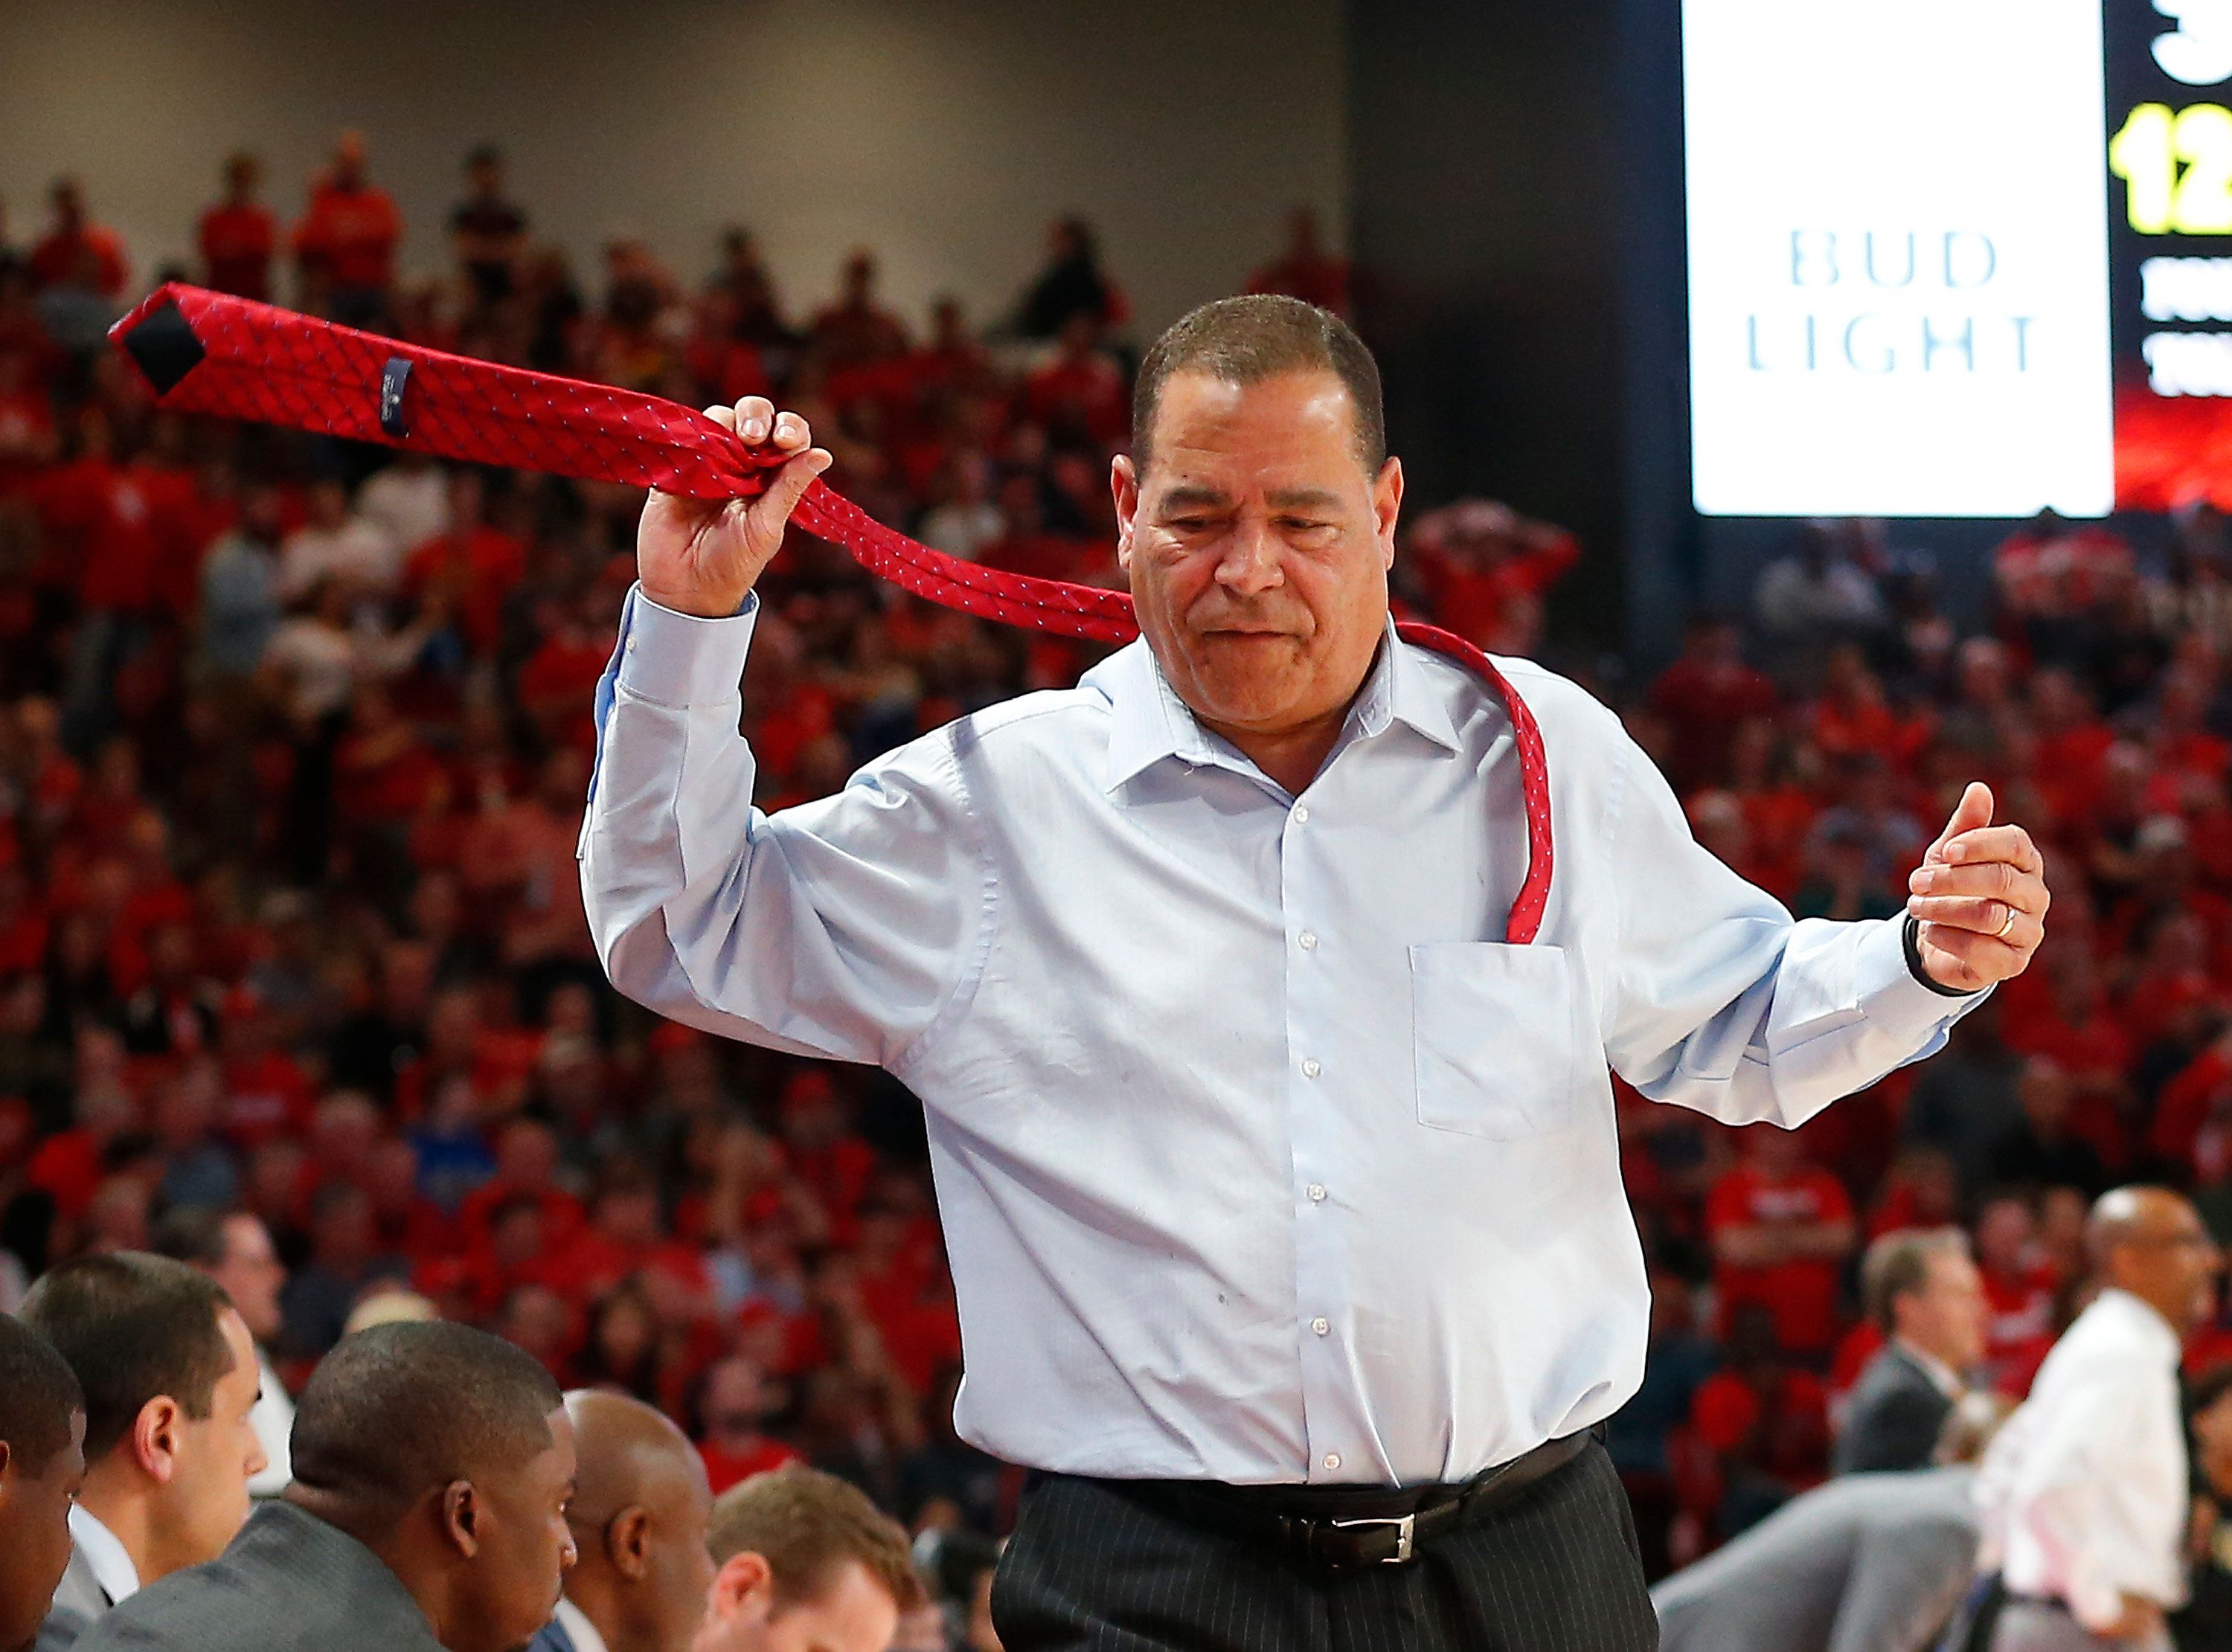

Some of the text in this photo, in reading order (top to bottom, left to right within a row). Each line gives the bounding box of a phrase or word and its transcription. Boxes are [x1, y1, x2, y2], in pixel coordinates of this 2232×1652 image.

[2108, 100, 2232, 236] 12
[1789, 228, 1998, 289] BUD
[1745, 313, 2036, 373] LIGHT
